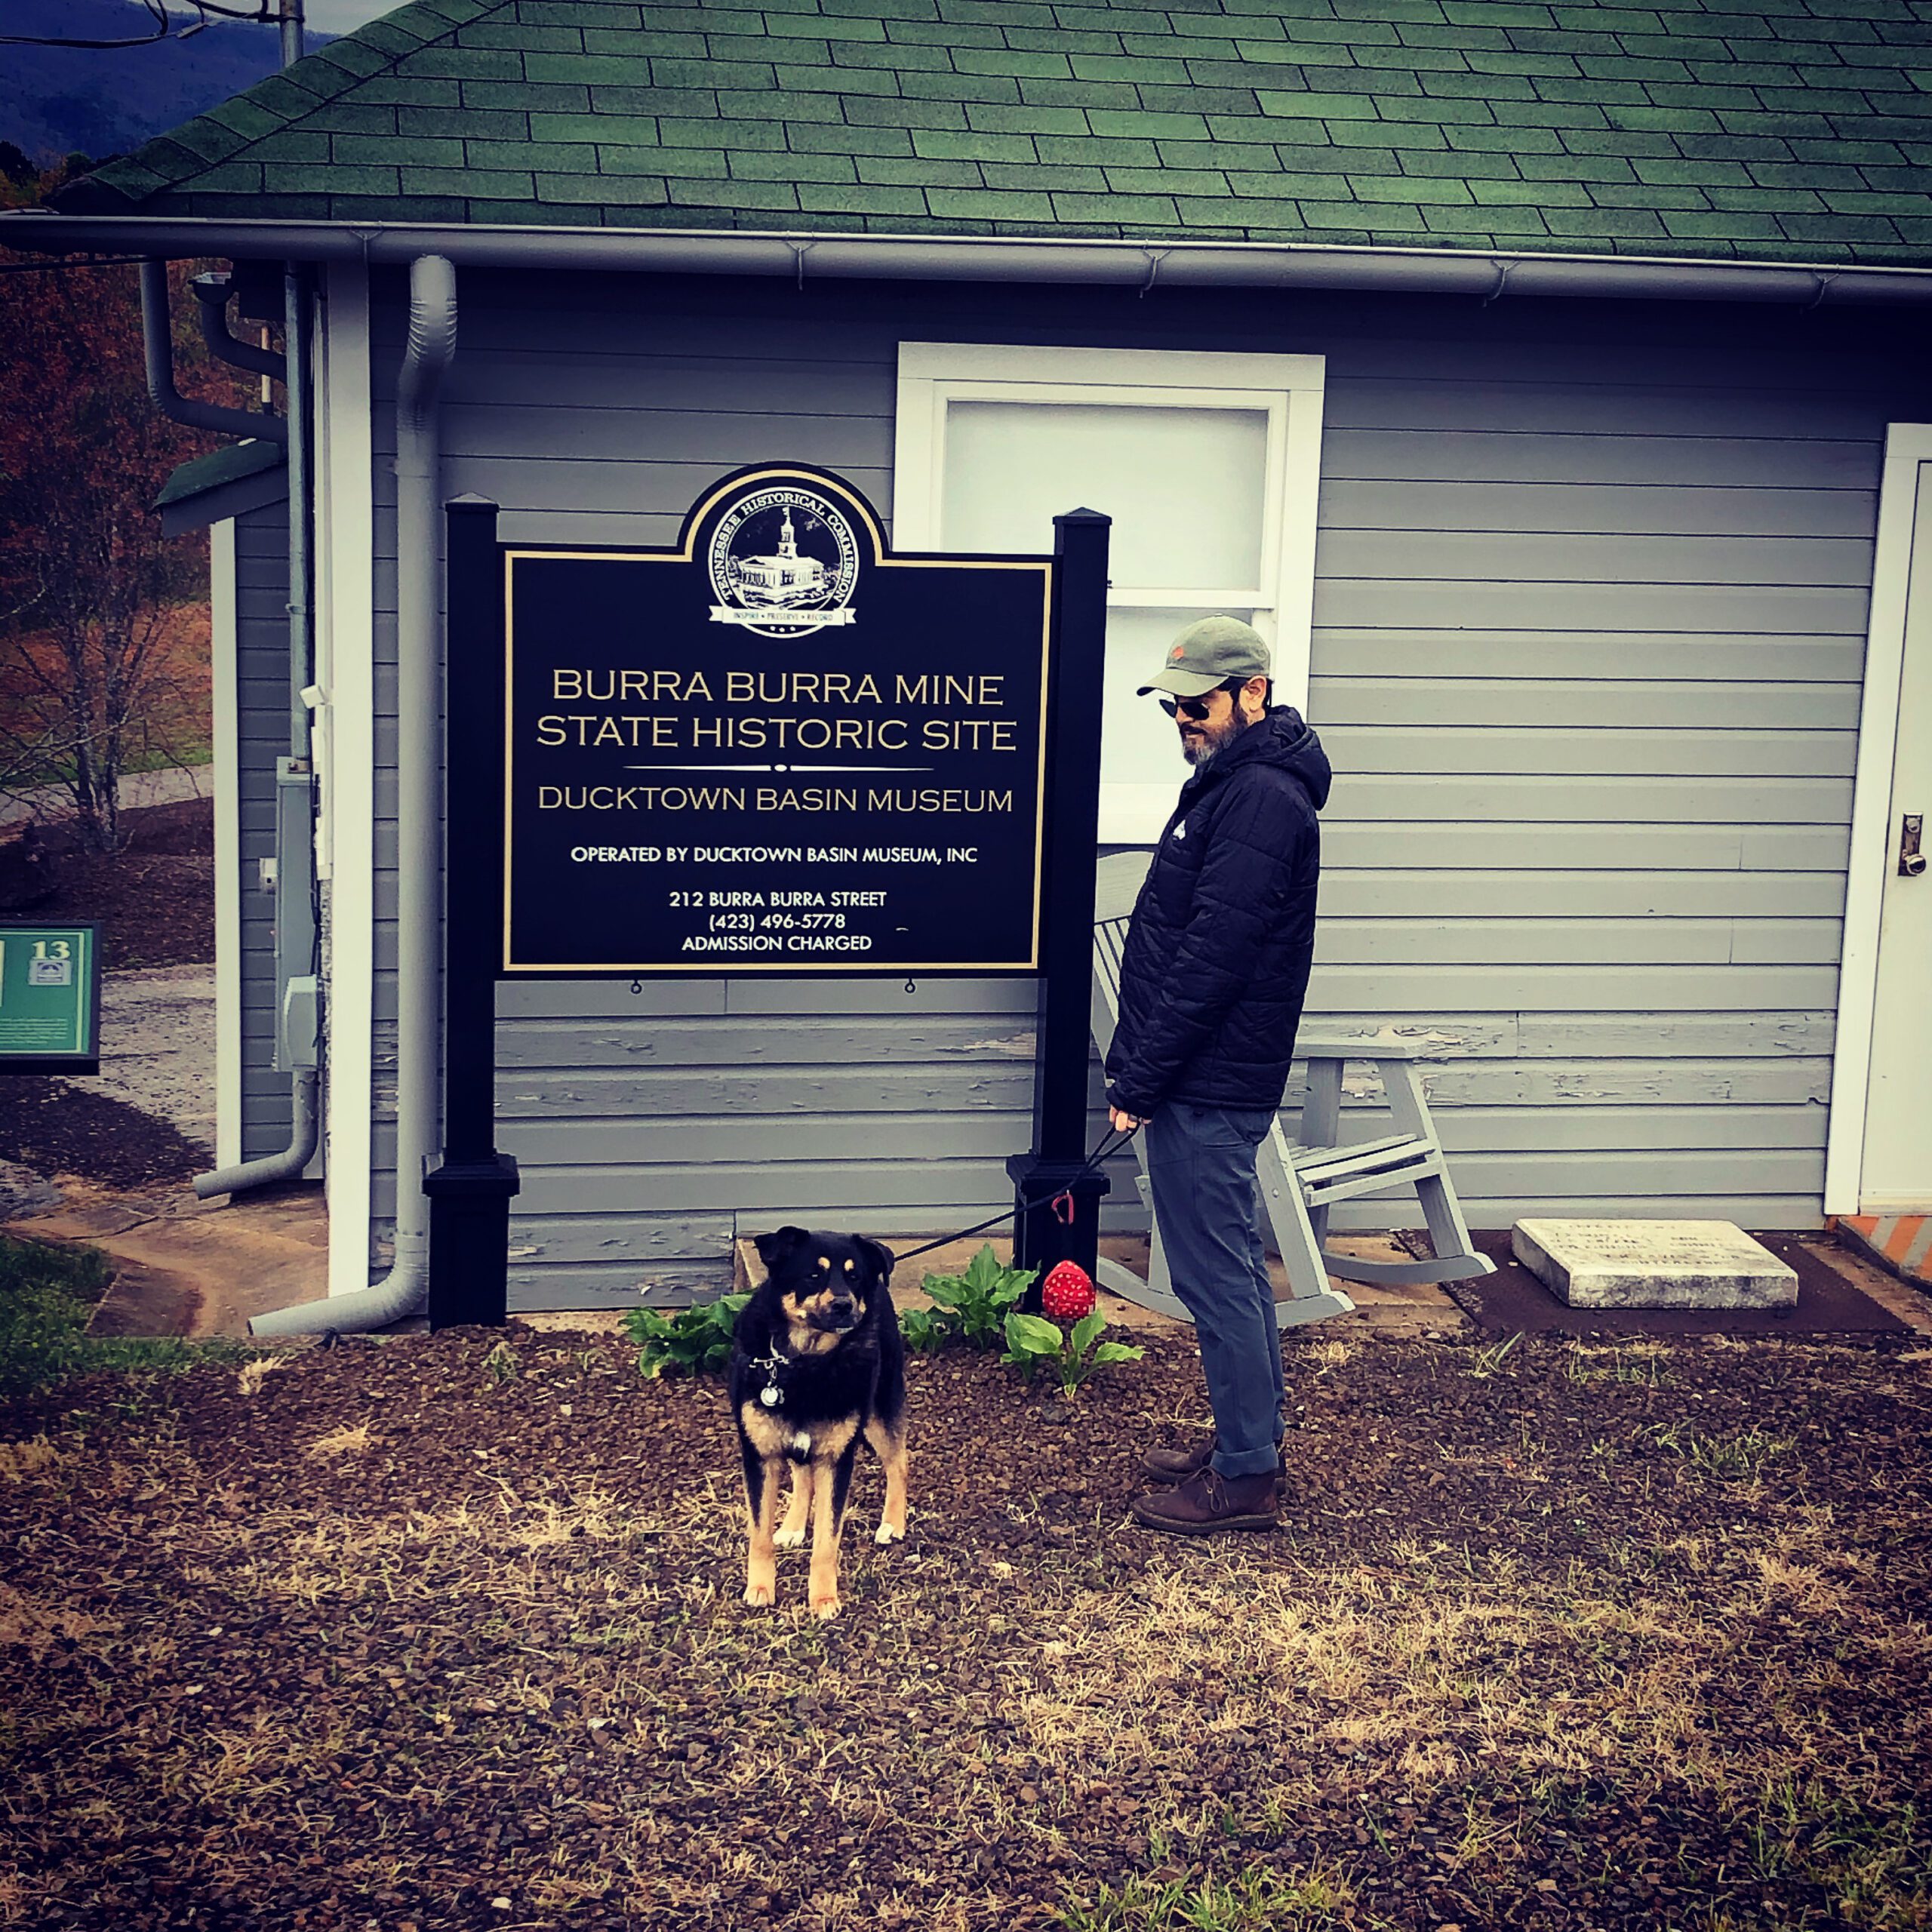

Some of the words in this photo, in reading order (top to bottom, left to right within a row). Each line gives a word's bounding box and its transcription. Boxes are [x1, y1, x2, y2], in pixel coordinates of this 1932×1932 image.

[714, 515, 742, 601] TENNESSEE
[742, 492, 826, 517] HISTORICAL
[827, 515, 855, 603] COMMISSION
[553, 669, 714, 701] BURRA
[726, 672, 883, 703] BURRA
[895, 674, 1004, 706] MINE
[537, 715, 678, 748] STATE
[693, 717, 909, 749] HISTORIC
[921, 720, 1017, 752] SITE
[539, 786, 746, 811] DUCKTOWN
[756, 788, 857, 811] BASIN
[868, 789, 1013, 812] MUSEUM
[571, 846, 662, 863] OPERATED
[666, 847, 689, 863] BY
[694, 846, 801, 863] DUCKTOWN
[807, 846, 857, 863] BASIN
[862, 847, 942, 866] MUSEUM,
[946, 847, 978, 863] INC
[669, 891, 704, 907] 212
[709, 891, 765, 907] BURRA
[770, 891, 826, 907] BURRA
[829, 891, 888, 907] STREET
[709, 913, 755, 933] (423)
[759, 913, 846, 929] 496-5778
[32, 940, 71, 960] 13
[681, 935, 783, 952] ADMISSION
[787, 935, 872, 951] CHARGED
